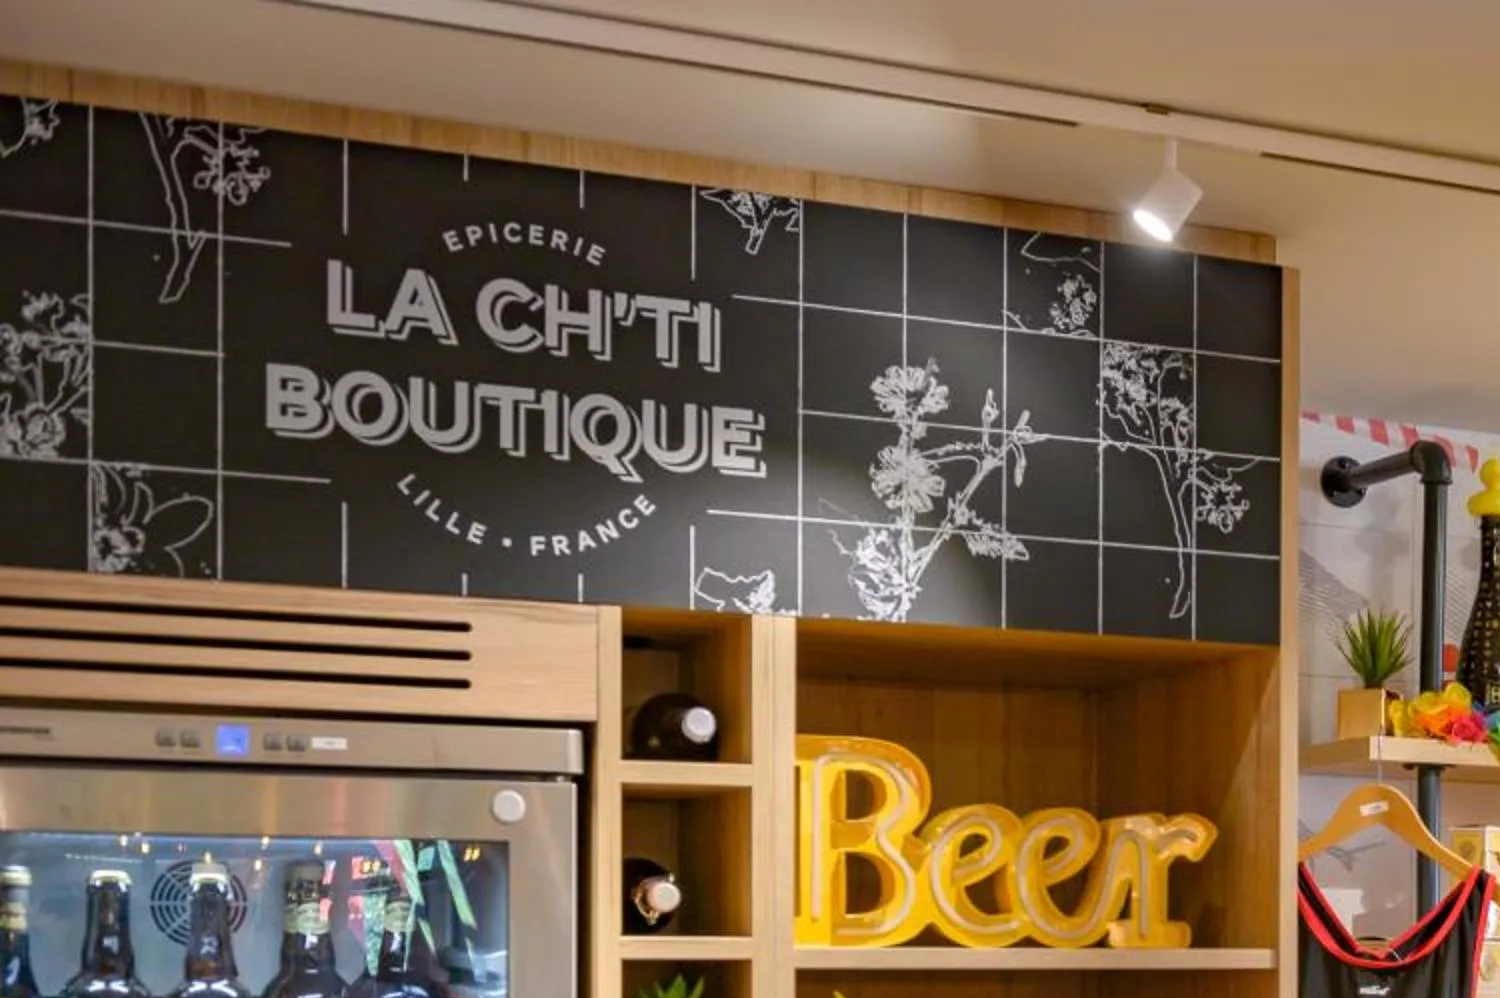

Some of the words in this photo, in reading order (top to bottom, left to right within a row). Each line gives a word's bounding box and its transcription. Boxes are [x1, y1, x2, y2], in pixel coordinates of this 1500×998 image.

[442, 221, 606, 266] EPICERIE
[327, 259, 457, 345] LA
[475, 277, 721, 373] CH'TI
[265, 363, 766, 482] BOUTIQUE
[397, 473, 487, 546] LILLE
[529, 494, 656, 557] FRANCE
[793, 734, 1219, 949] Beer
